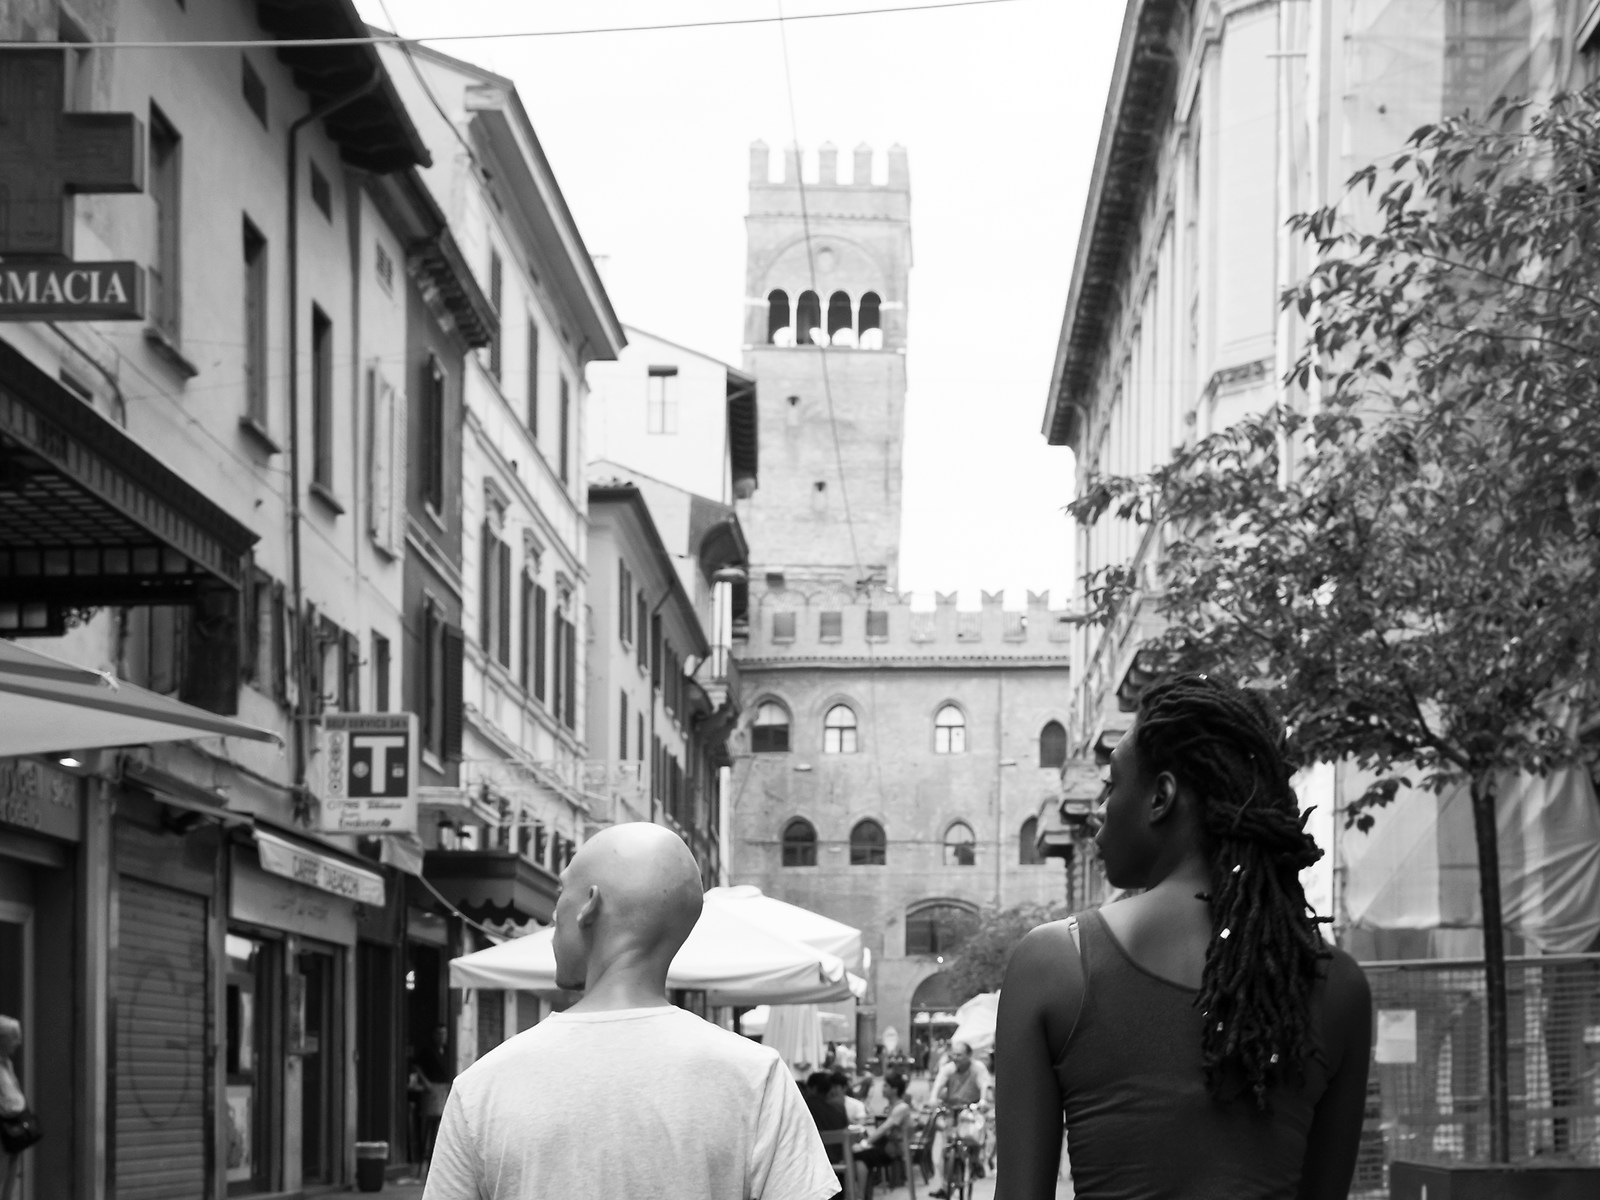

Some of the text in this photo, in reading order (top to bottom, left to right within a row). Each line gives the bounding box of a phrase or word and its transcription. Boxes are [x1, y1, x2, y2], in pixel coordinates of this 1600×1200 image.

[0, 269, 128, 304] MACIA
[349, 717, 386, 730] SERVICE
[352, 735, 405, 794] T
